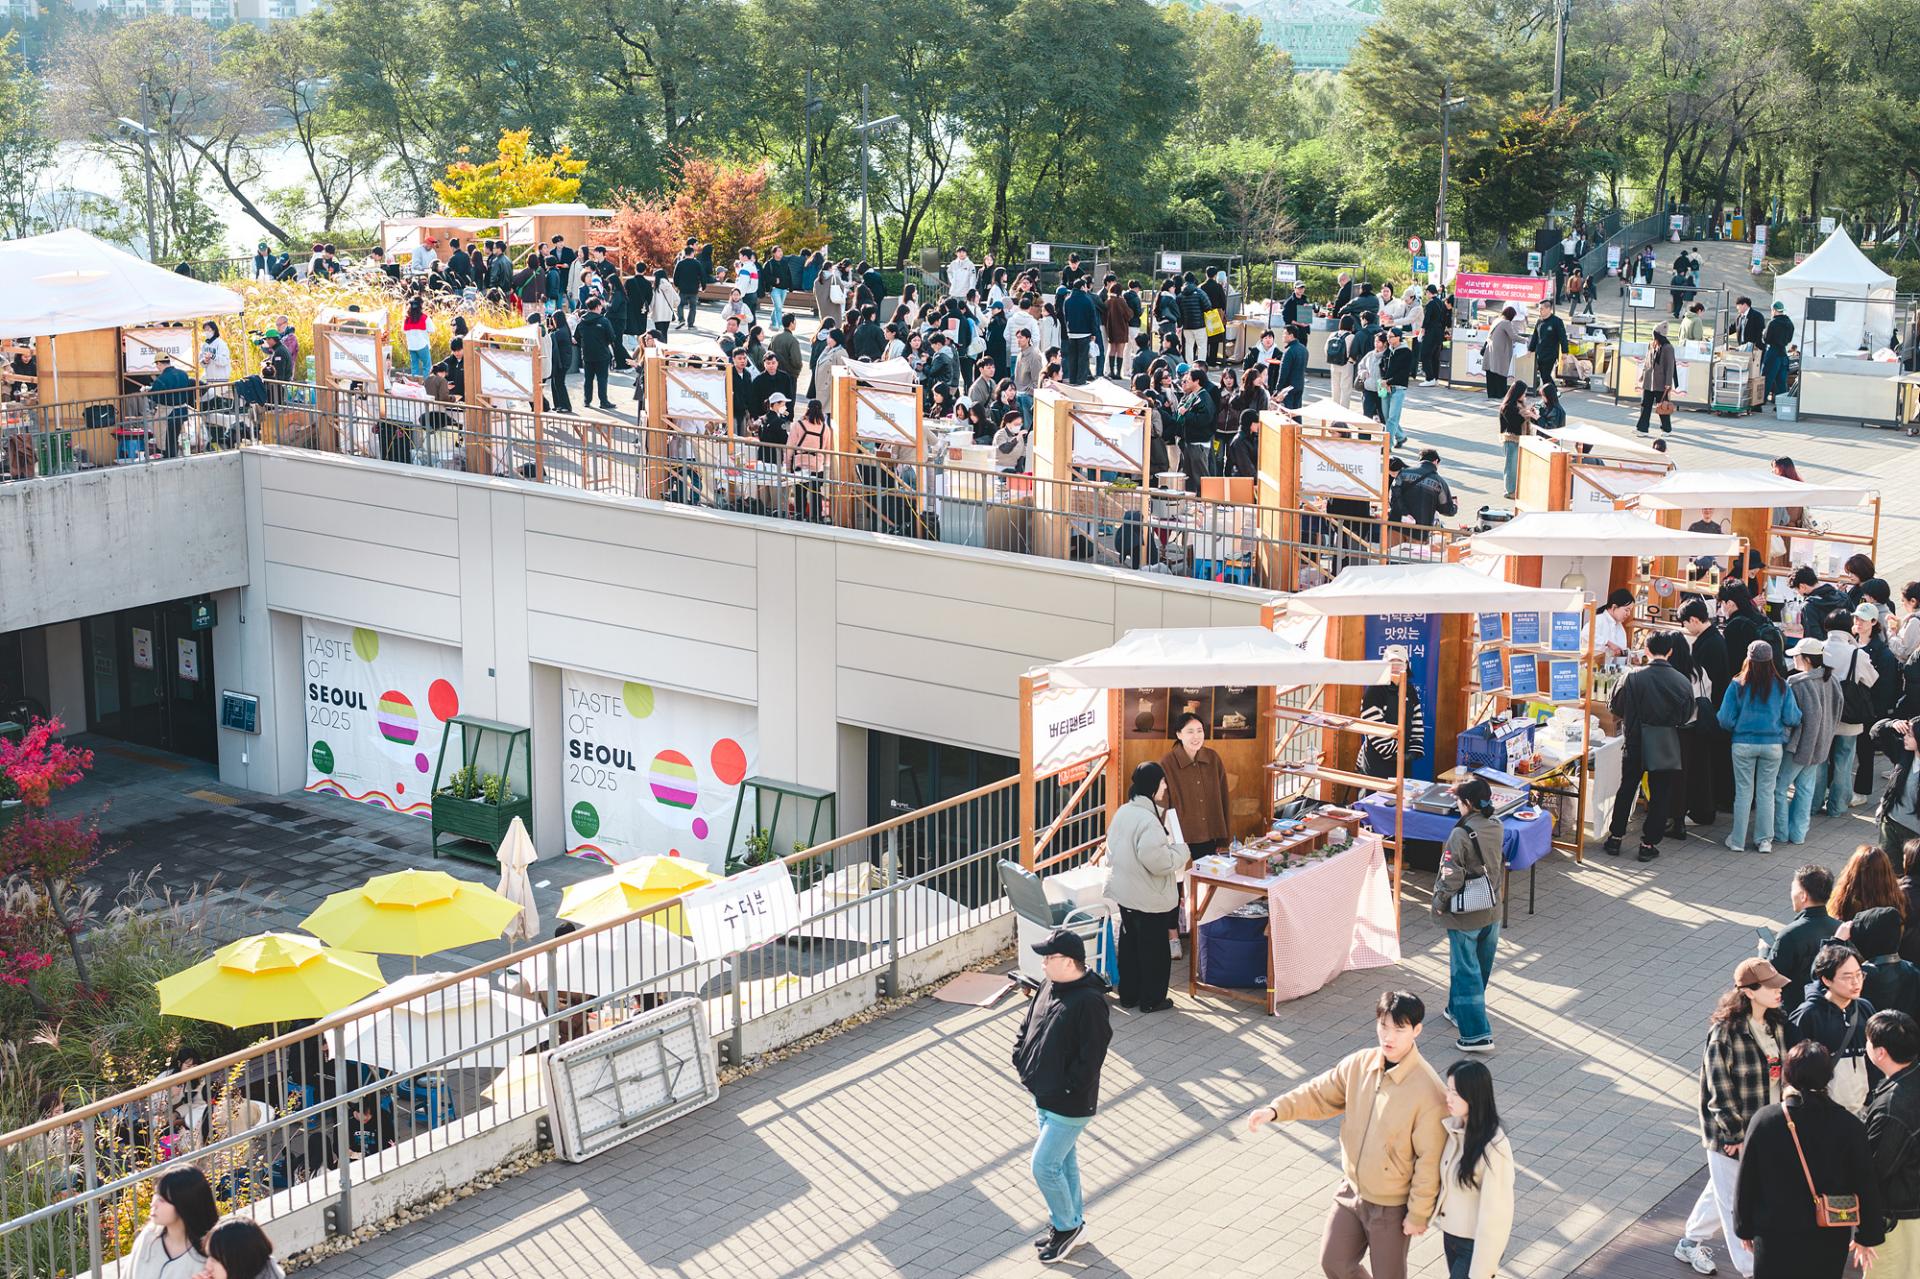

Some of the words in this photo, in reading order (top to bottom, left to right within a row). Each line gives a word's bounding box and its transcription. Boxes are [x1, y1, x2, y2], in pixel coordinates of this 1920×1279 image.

[1384, 626, 1420, 641] 맛있는
[307, 635, 352, 661] TASTE
[308, 659, 329, 680] OF
[309, 682, 368, 711] SEOUL
[568, 688, 622, 717] TASTE
[310, 705, 351, 730] 2025
[568, 714, 594, 735] OF
[1049, 709, 1095, 738] 버터팬트리
[569, 739, 637, 772] SEOUL
[569, 763, 618, 791] 2025
[723, 889, 767, 929] 수더분
